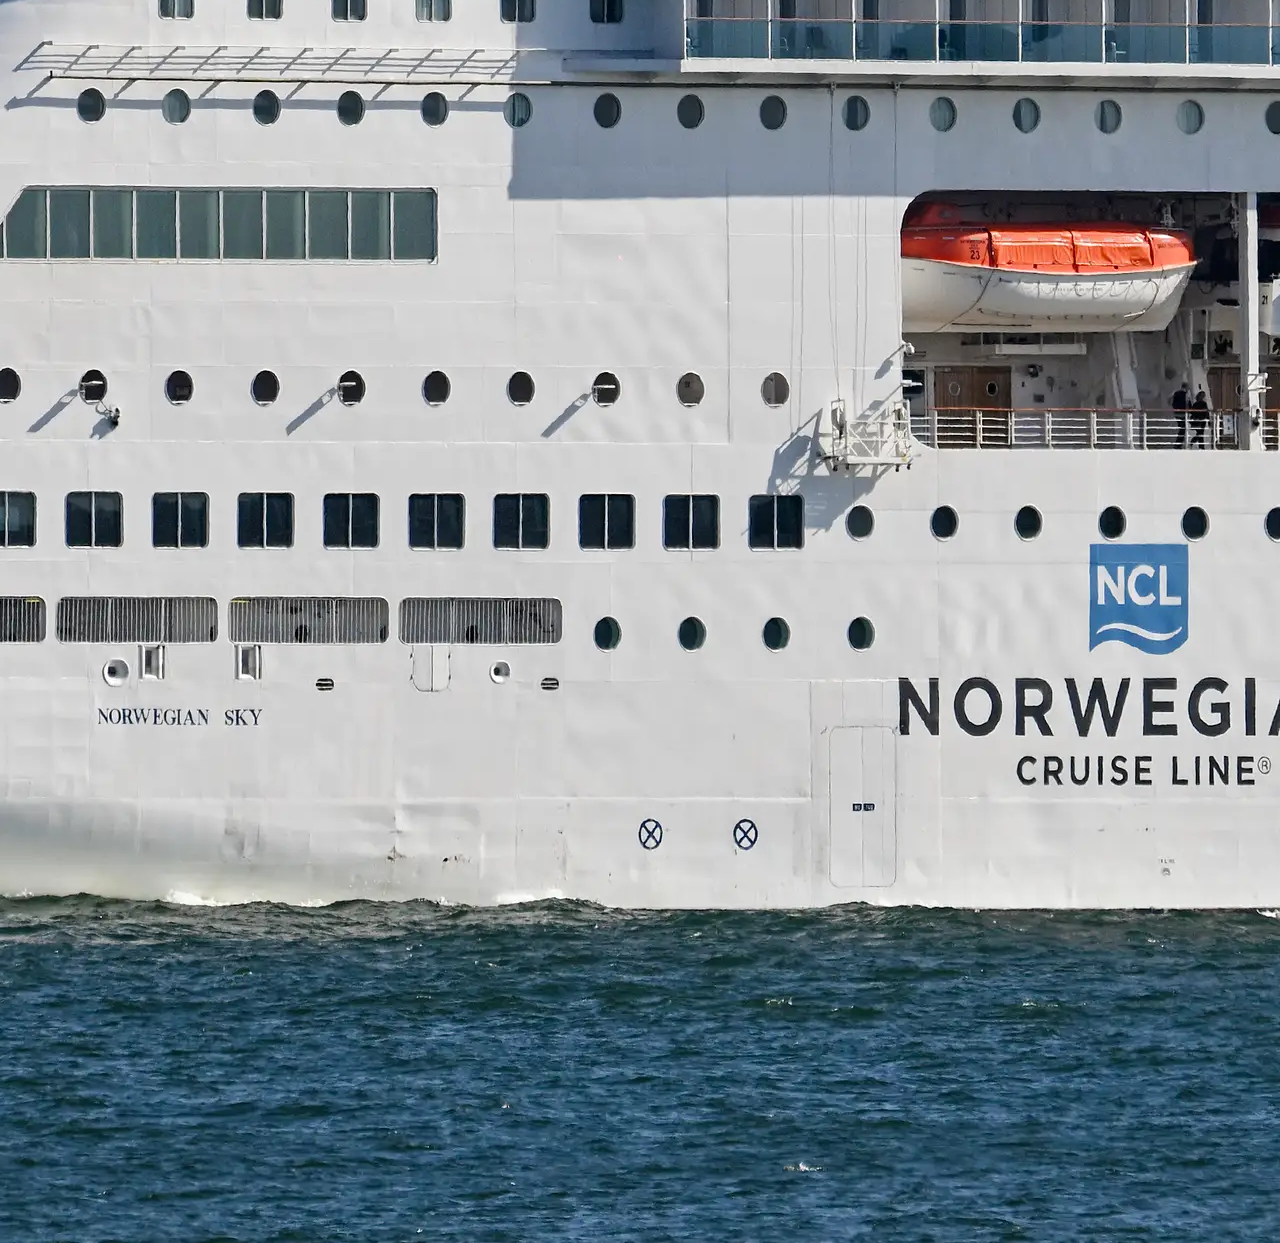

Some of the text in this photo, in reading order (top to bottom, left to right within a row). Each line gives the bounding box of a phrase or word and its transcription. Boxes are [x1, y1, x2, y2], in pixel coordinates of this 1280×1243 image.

[970, 249, 980, 260] 23
[1096, 564, 1182, 606] NCL
[97, 708, 263, 726] NORWEGIAN SKY
[1016, 755, 1153, 786] CRUISE
